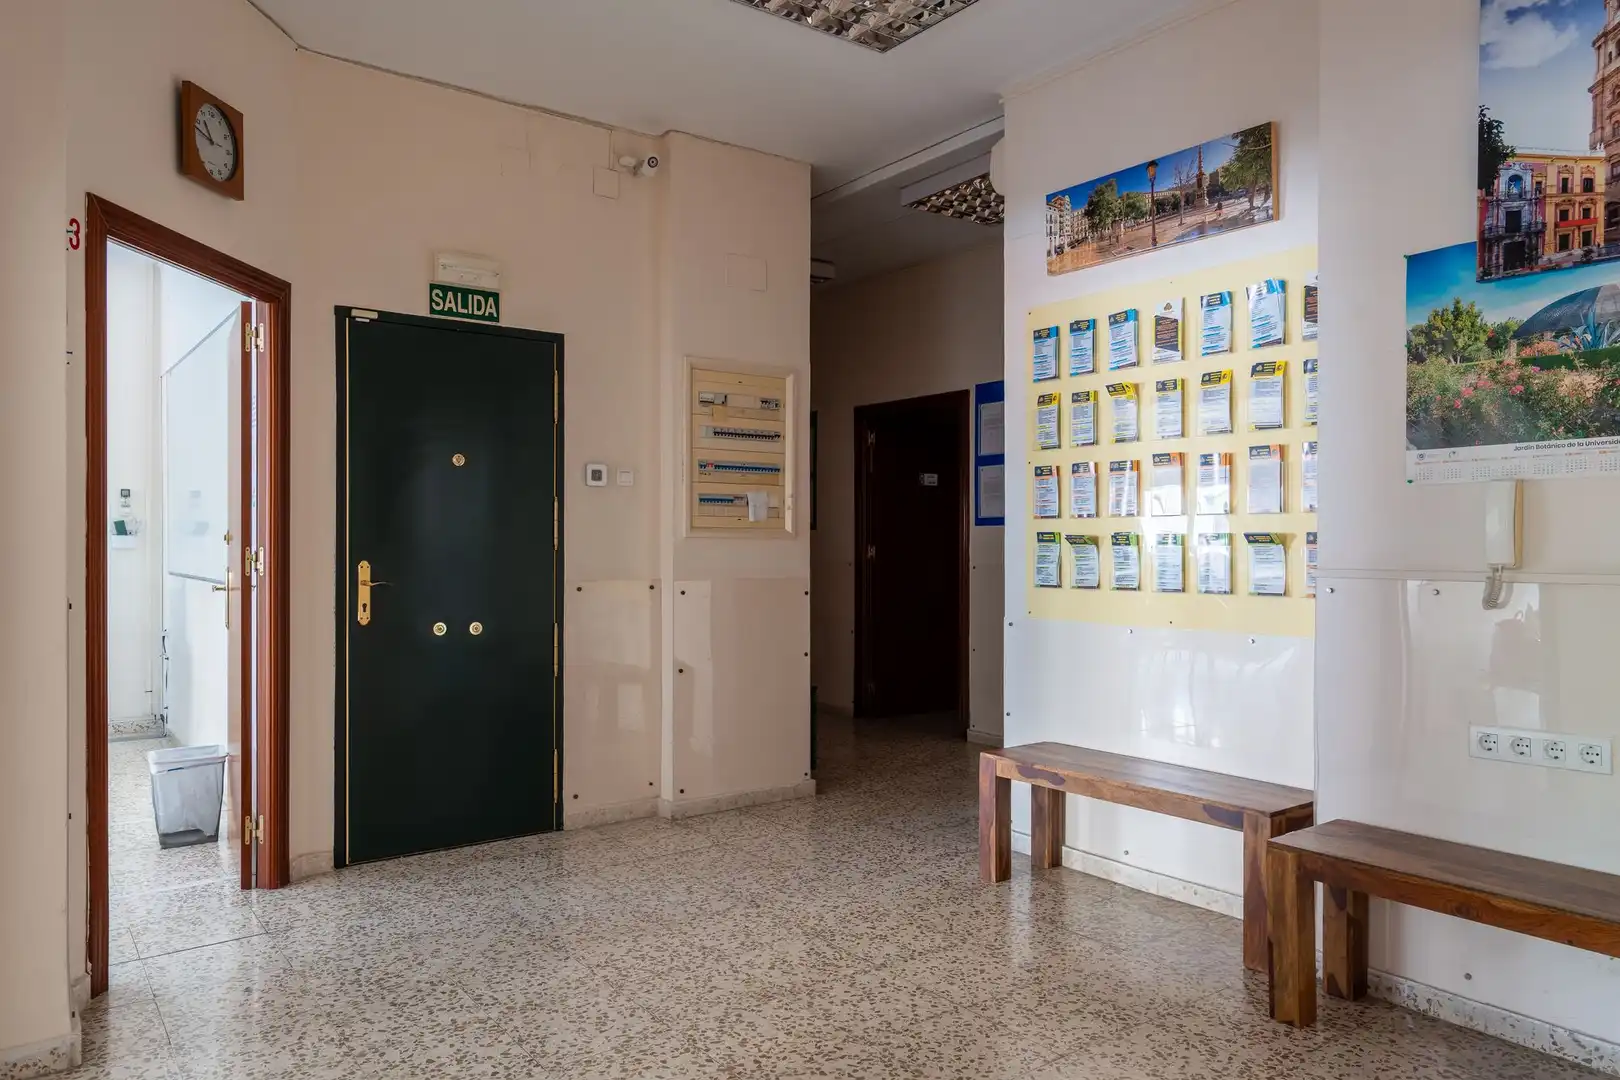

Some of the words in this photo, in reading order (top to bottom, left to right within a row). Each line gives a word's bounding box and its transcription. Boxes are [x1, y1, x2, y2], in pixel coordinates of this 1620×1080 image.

[69, 218, 80, 250] 3
[431, 288, 498, 317] SALIDA
[1536, 442, 1566, 450] Botánico
